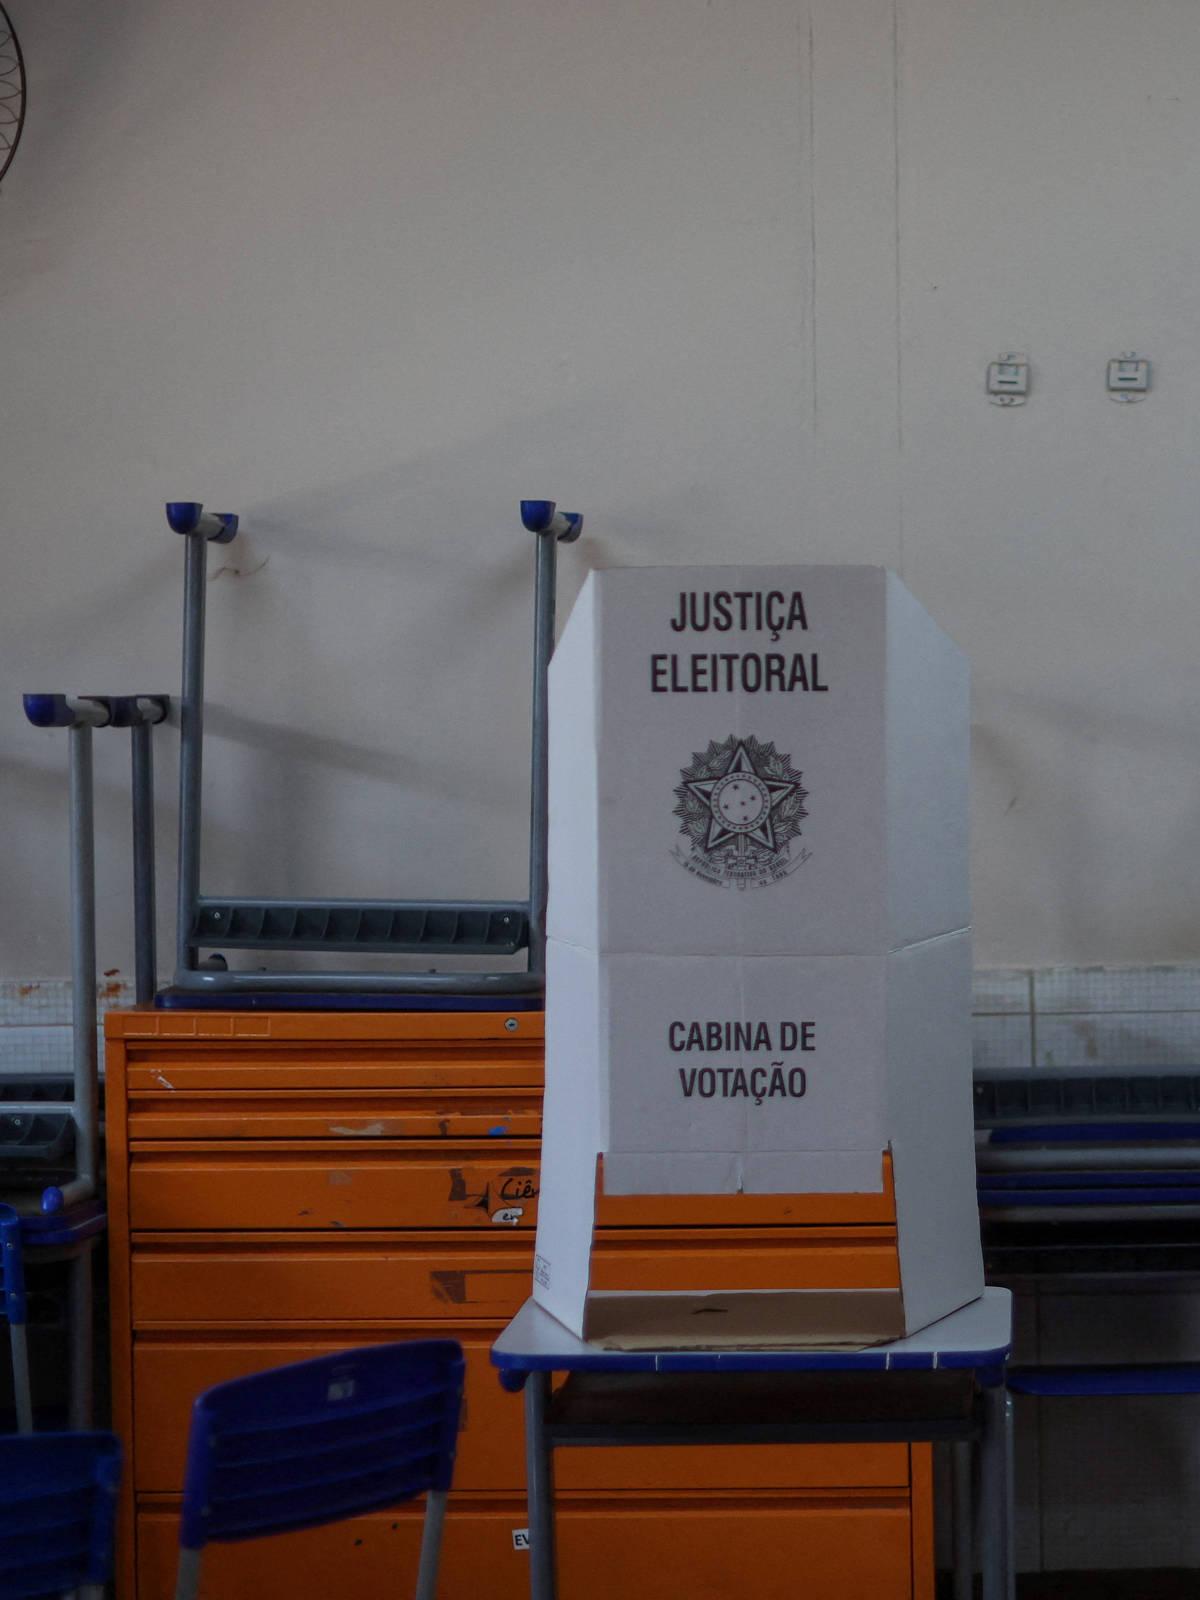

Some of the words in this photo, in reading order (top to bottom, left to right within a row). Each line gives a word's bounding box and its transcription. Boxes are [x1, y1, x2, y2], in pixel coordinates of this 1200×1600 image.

[670, 590, 809, 642] JUSTIÇA
[650, 652, 829, 694] ELEITORAL
[668, 1021, 773, 1051] CABINA
[780, 1021, 816, 1051] DE
[678, 1061, 807, 1105] VOTAÇÃO
